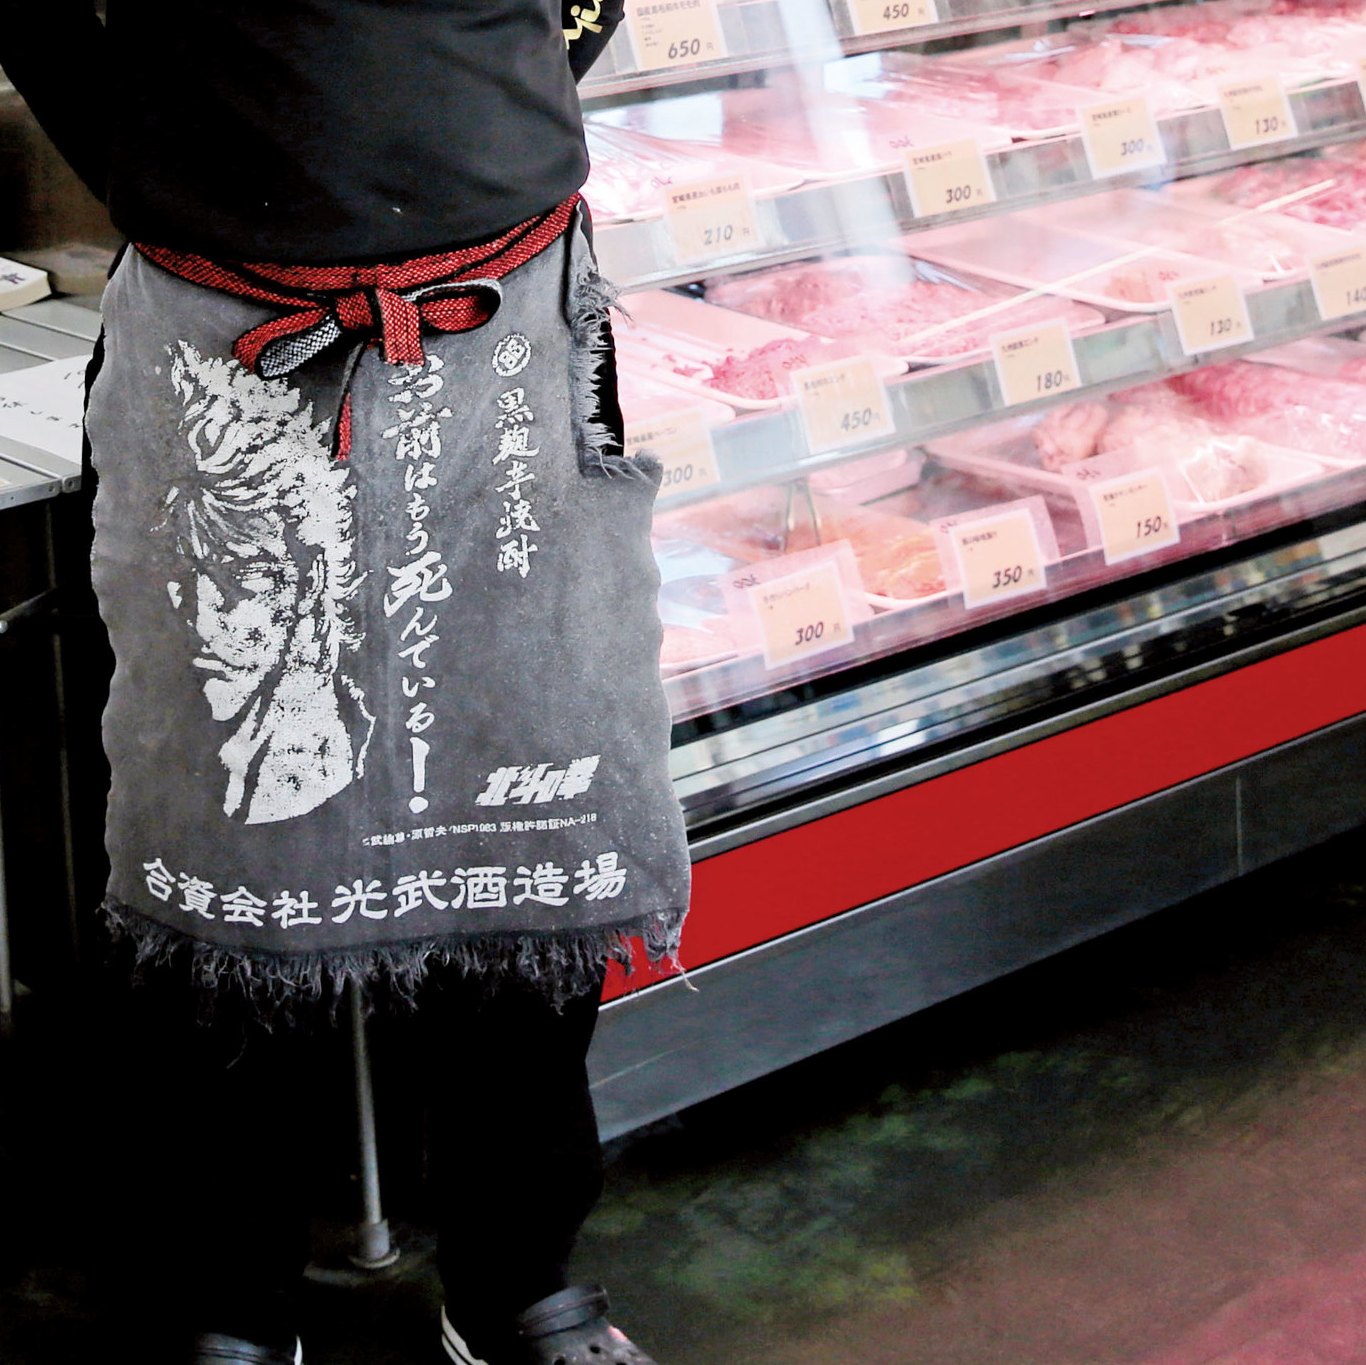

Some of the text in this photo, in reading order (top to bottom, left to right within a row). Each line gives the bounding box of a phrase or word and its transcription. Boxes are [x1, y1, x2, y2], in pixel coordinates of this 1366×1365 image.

[882, 3, 910, 20] 450
[668, 38, 701, 59] 650
[1255, 116, 1279, 135] 130
[1120, 138, 1145, 156] 300
[946, 185, 972, 204] 300
[703, 224, 733, 245] 210
[1210, 317, 1232, 336] 130
[1037, 369, 1063, 392] 180
[840, 408, 872, 431] 450
[663, 463, 693, 488] 300
[1136, 515, 1163, 539] 150
[992, 565, 1023, 589] 350
[794, 621, 824, 646] 300
[142, 849, 629, 931] 合資会社 光武酒造場
